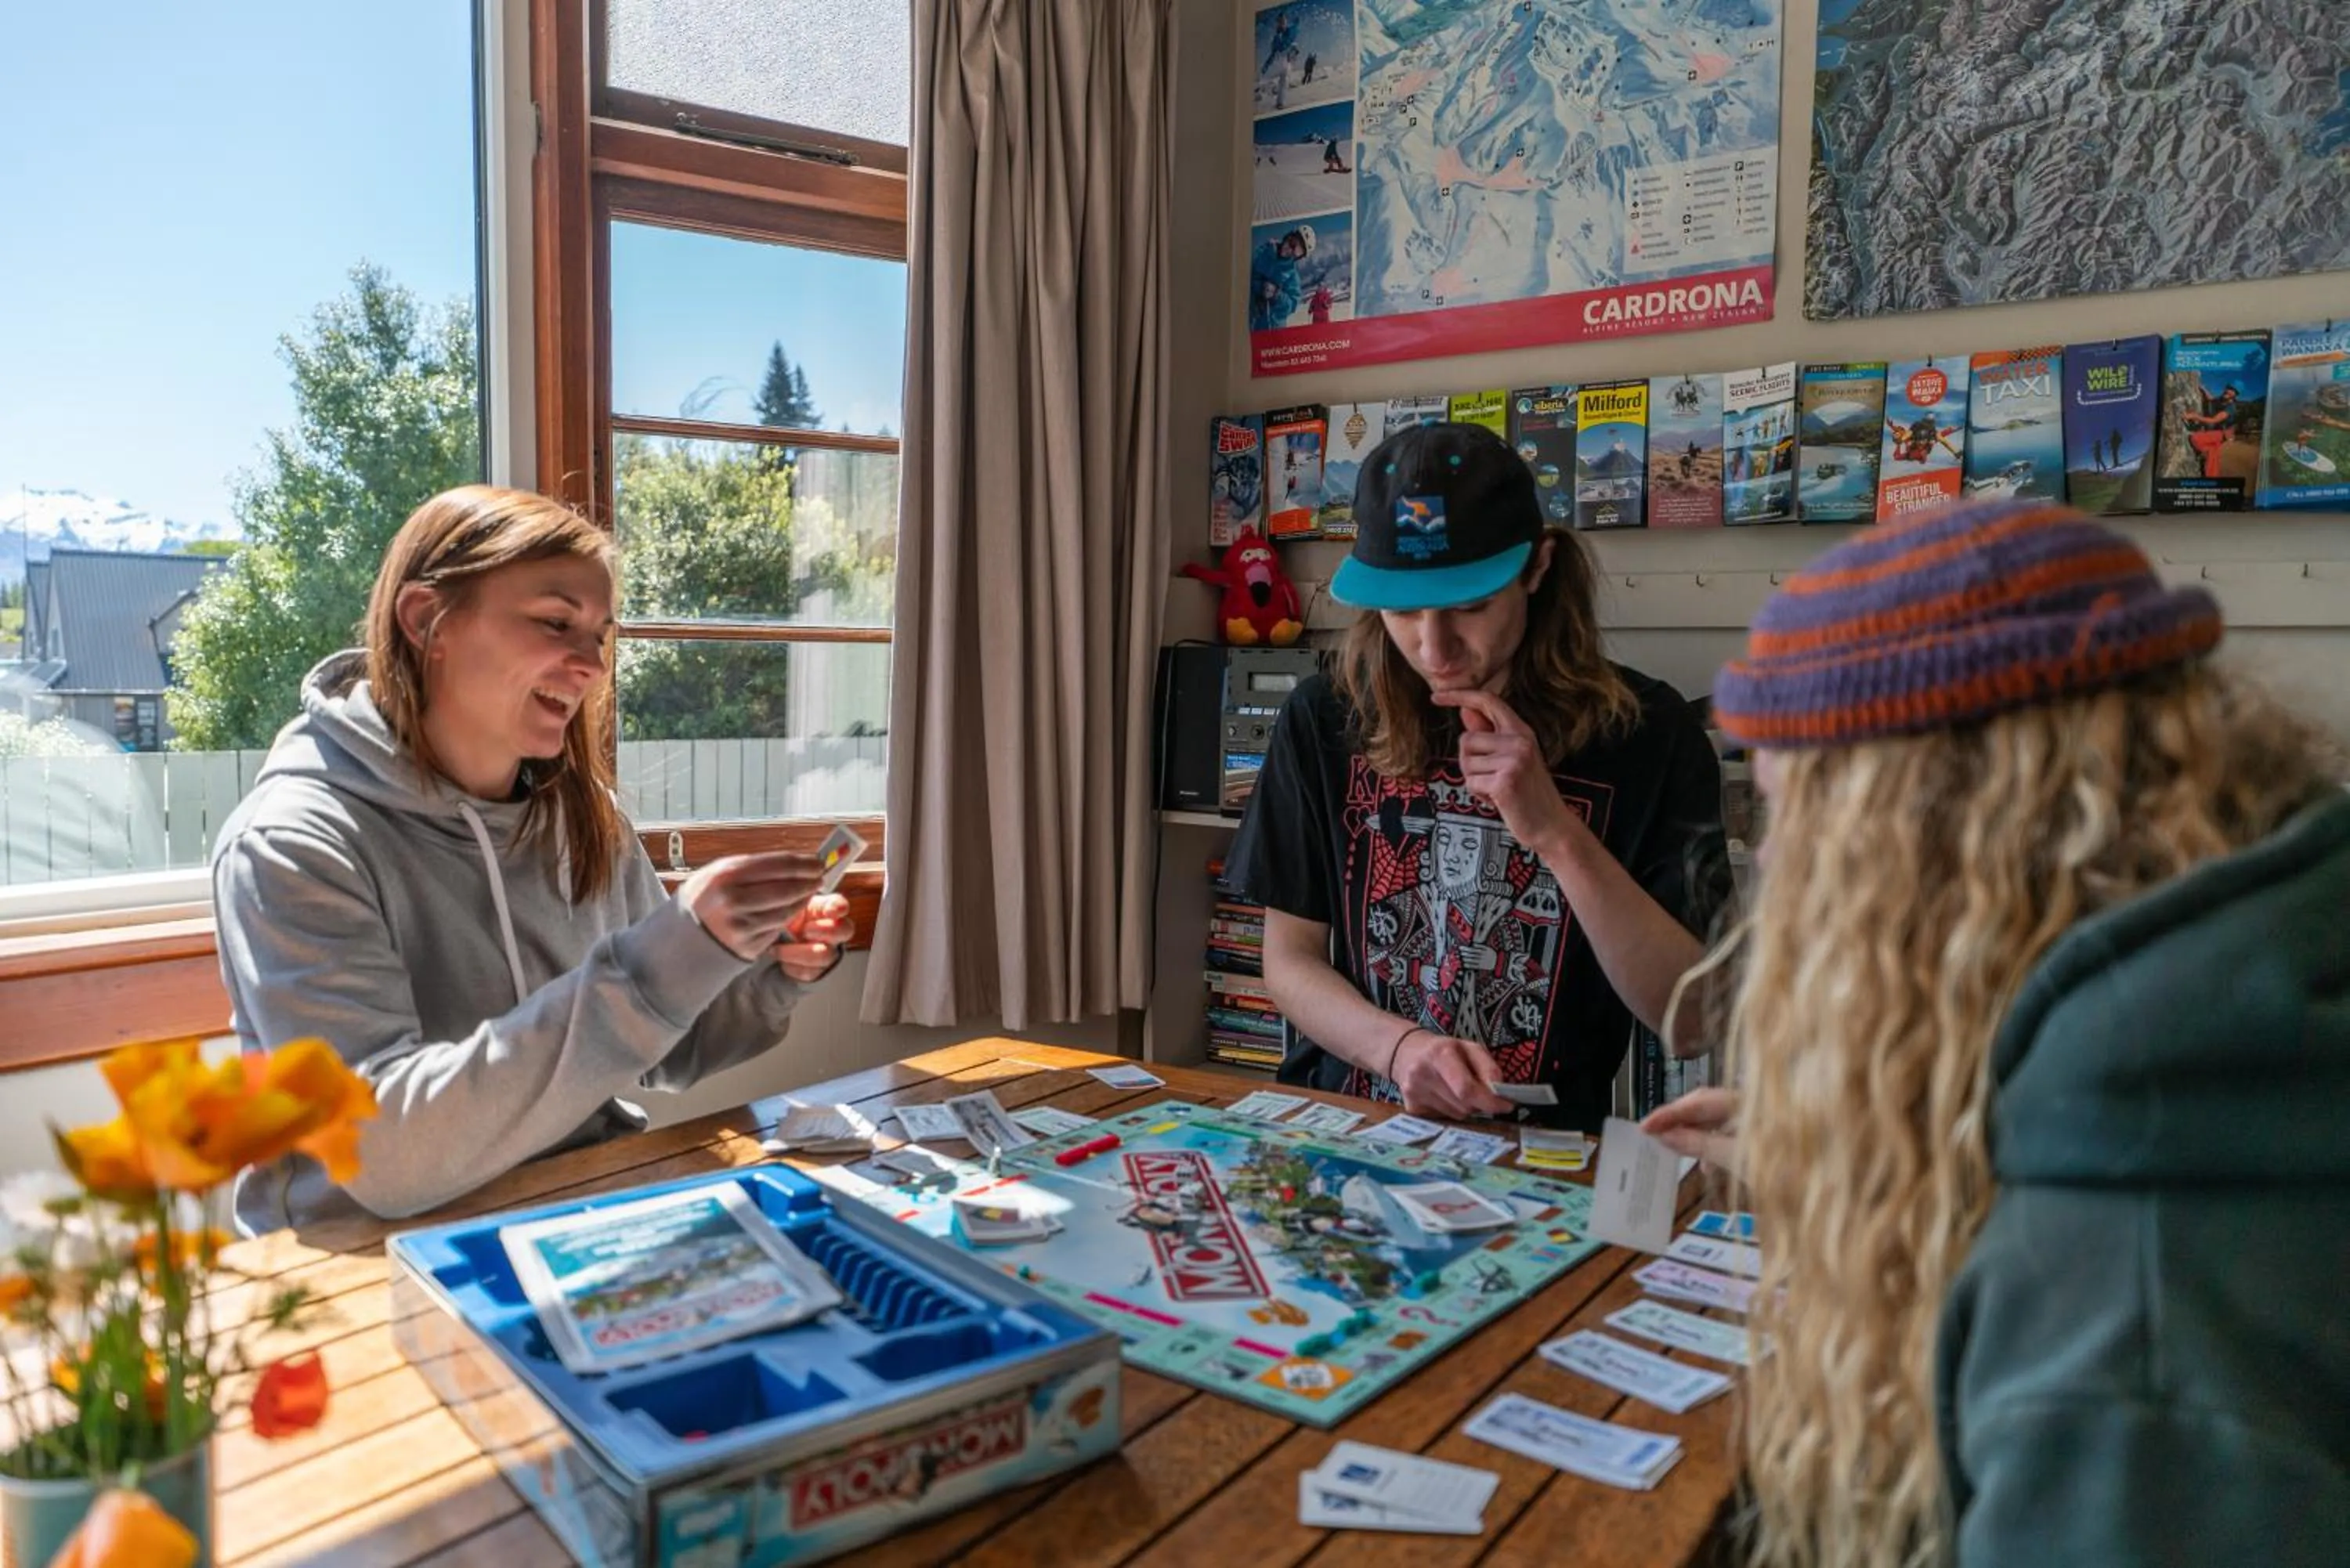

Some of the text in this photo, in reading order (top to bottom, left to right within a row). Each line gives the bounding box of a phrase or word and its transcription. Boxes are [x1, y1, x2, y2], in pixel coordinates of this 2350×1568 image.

[1583, 278, 1763, 325] CARDRONA
[1683, 313, 1706, 323] NEW
[2281, 343, 2342, 356] WANAKA
[1979, 361, 2051, 385] WATER
[2088, 364, 2128, 380] WILD
[1980, 374, 2052, 406] TAXI
[2087, 376, 2128, 391] WIRE
[1584, 391, 1642, 413] Milford
[1886, 482, 1943, 504] BEAUTIFUL
[1895, 494, 1951, 515] STRANGER
